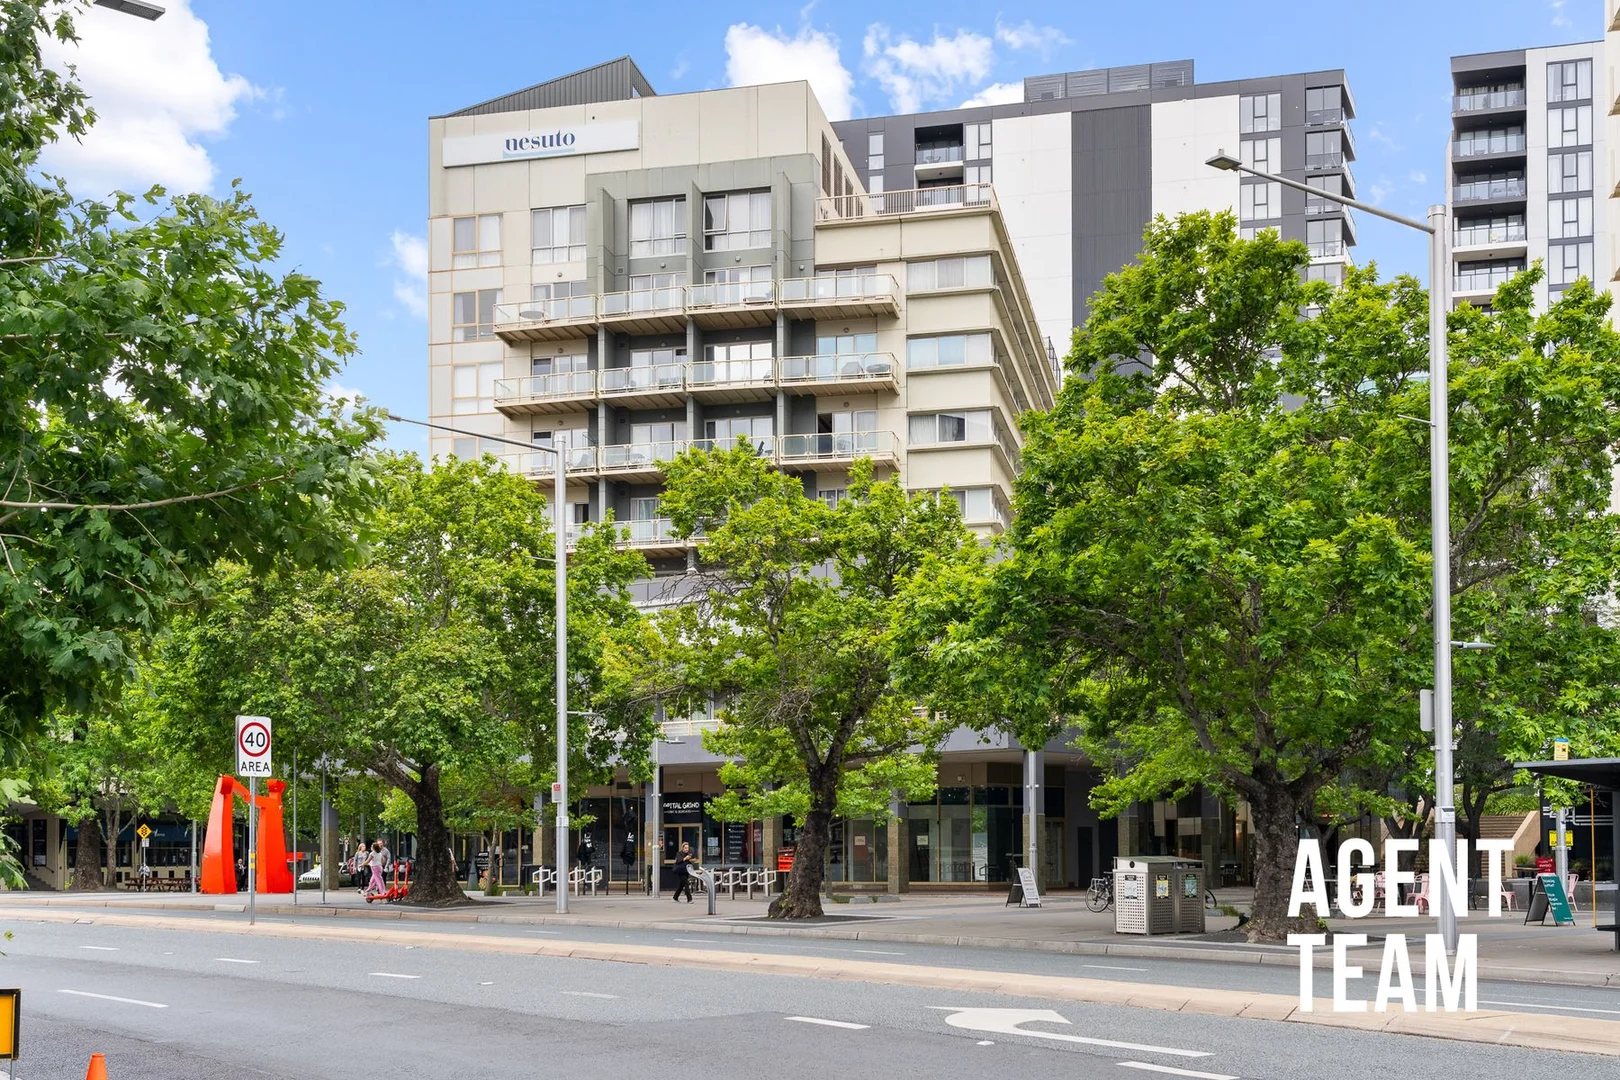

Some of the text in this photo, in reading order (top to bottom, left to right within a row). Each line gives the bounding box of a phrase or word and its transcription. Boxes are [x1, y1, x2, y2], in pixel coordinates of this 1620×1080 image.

[505, 130, 575, 151] nesuto
[245, 732, 265, 747] 40
[241, 761, 270, 772] AREA
